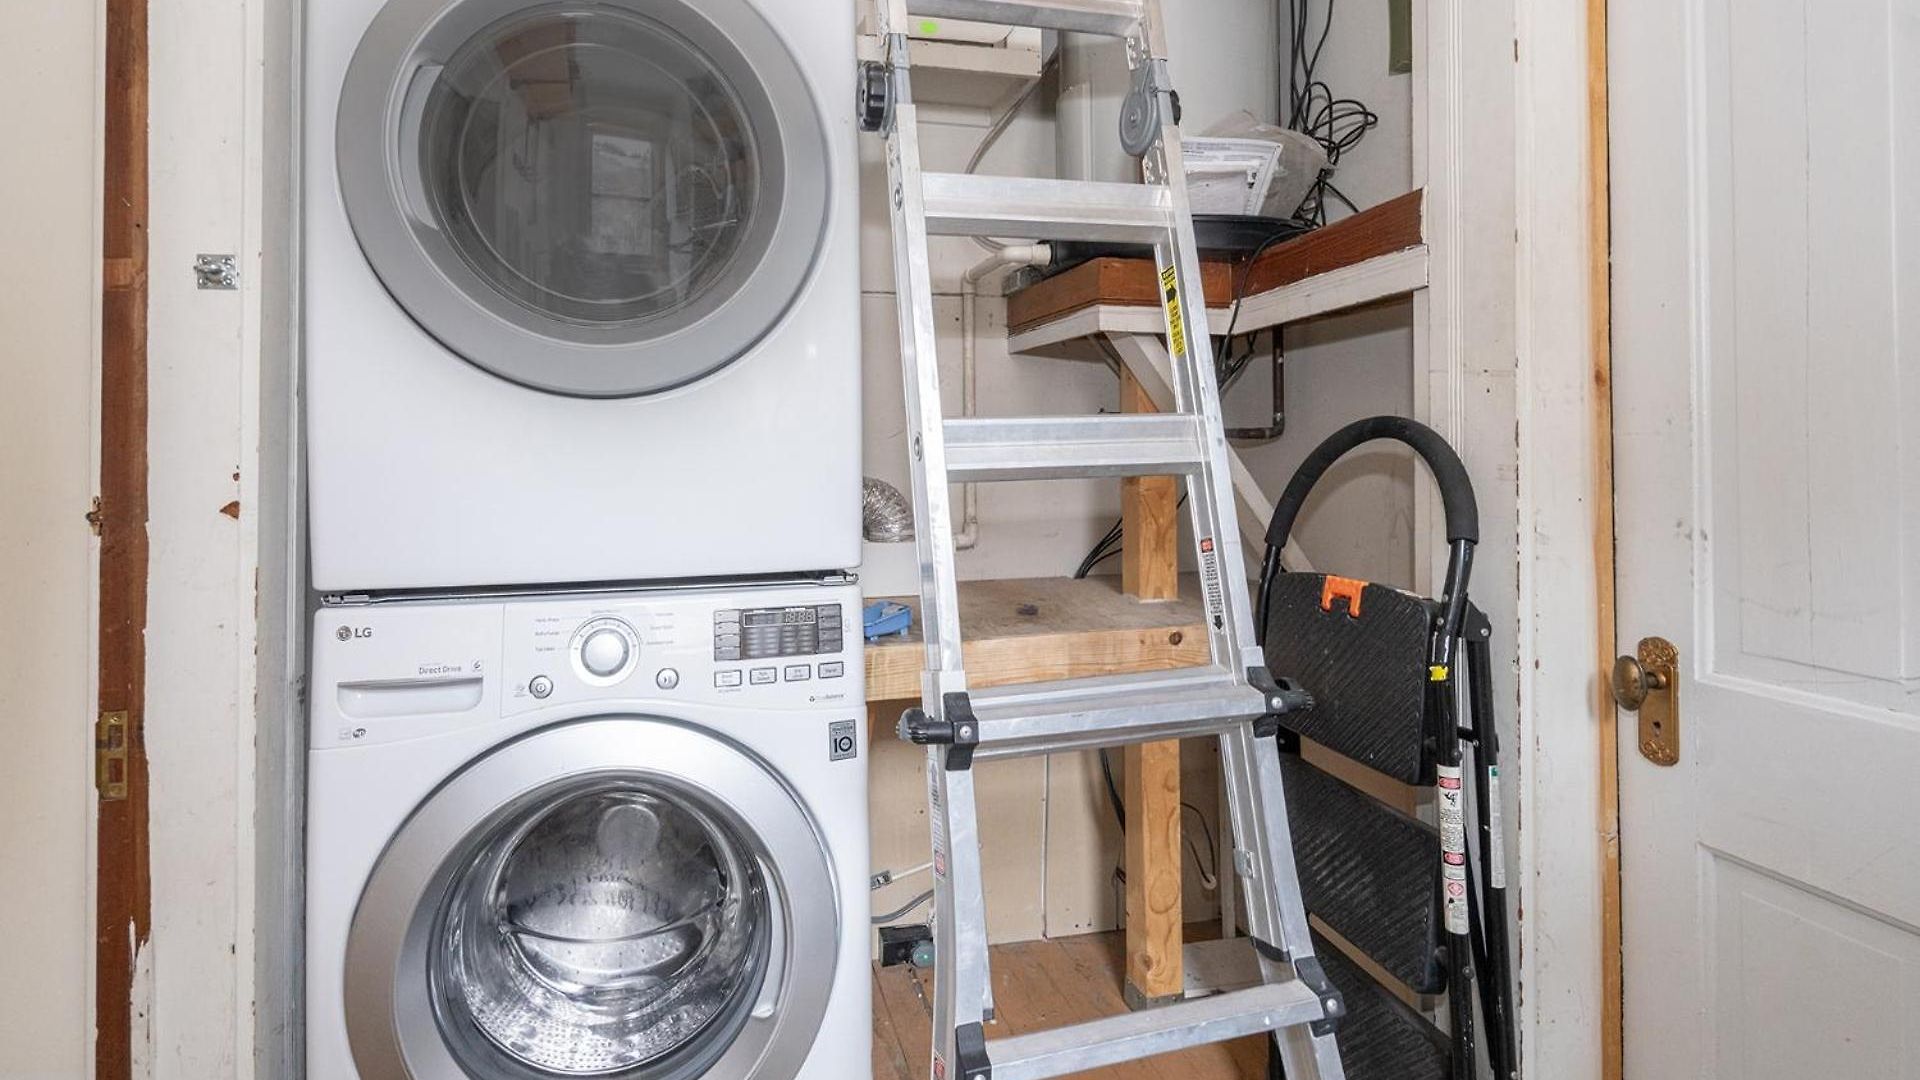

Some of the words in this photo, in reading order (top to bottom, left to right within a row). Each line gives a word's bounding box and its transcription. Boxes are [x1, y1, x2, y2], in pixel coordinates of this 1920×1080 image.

[355, 627, 372, 638] LG
[418, 666, 441, 675] Direct
[833, 735, 853, 754] 10
